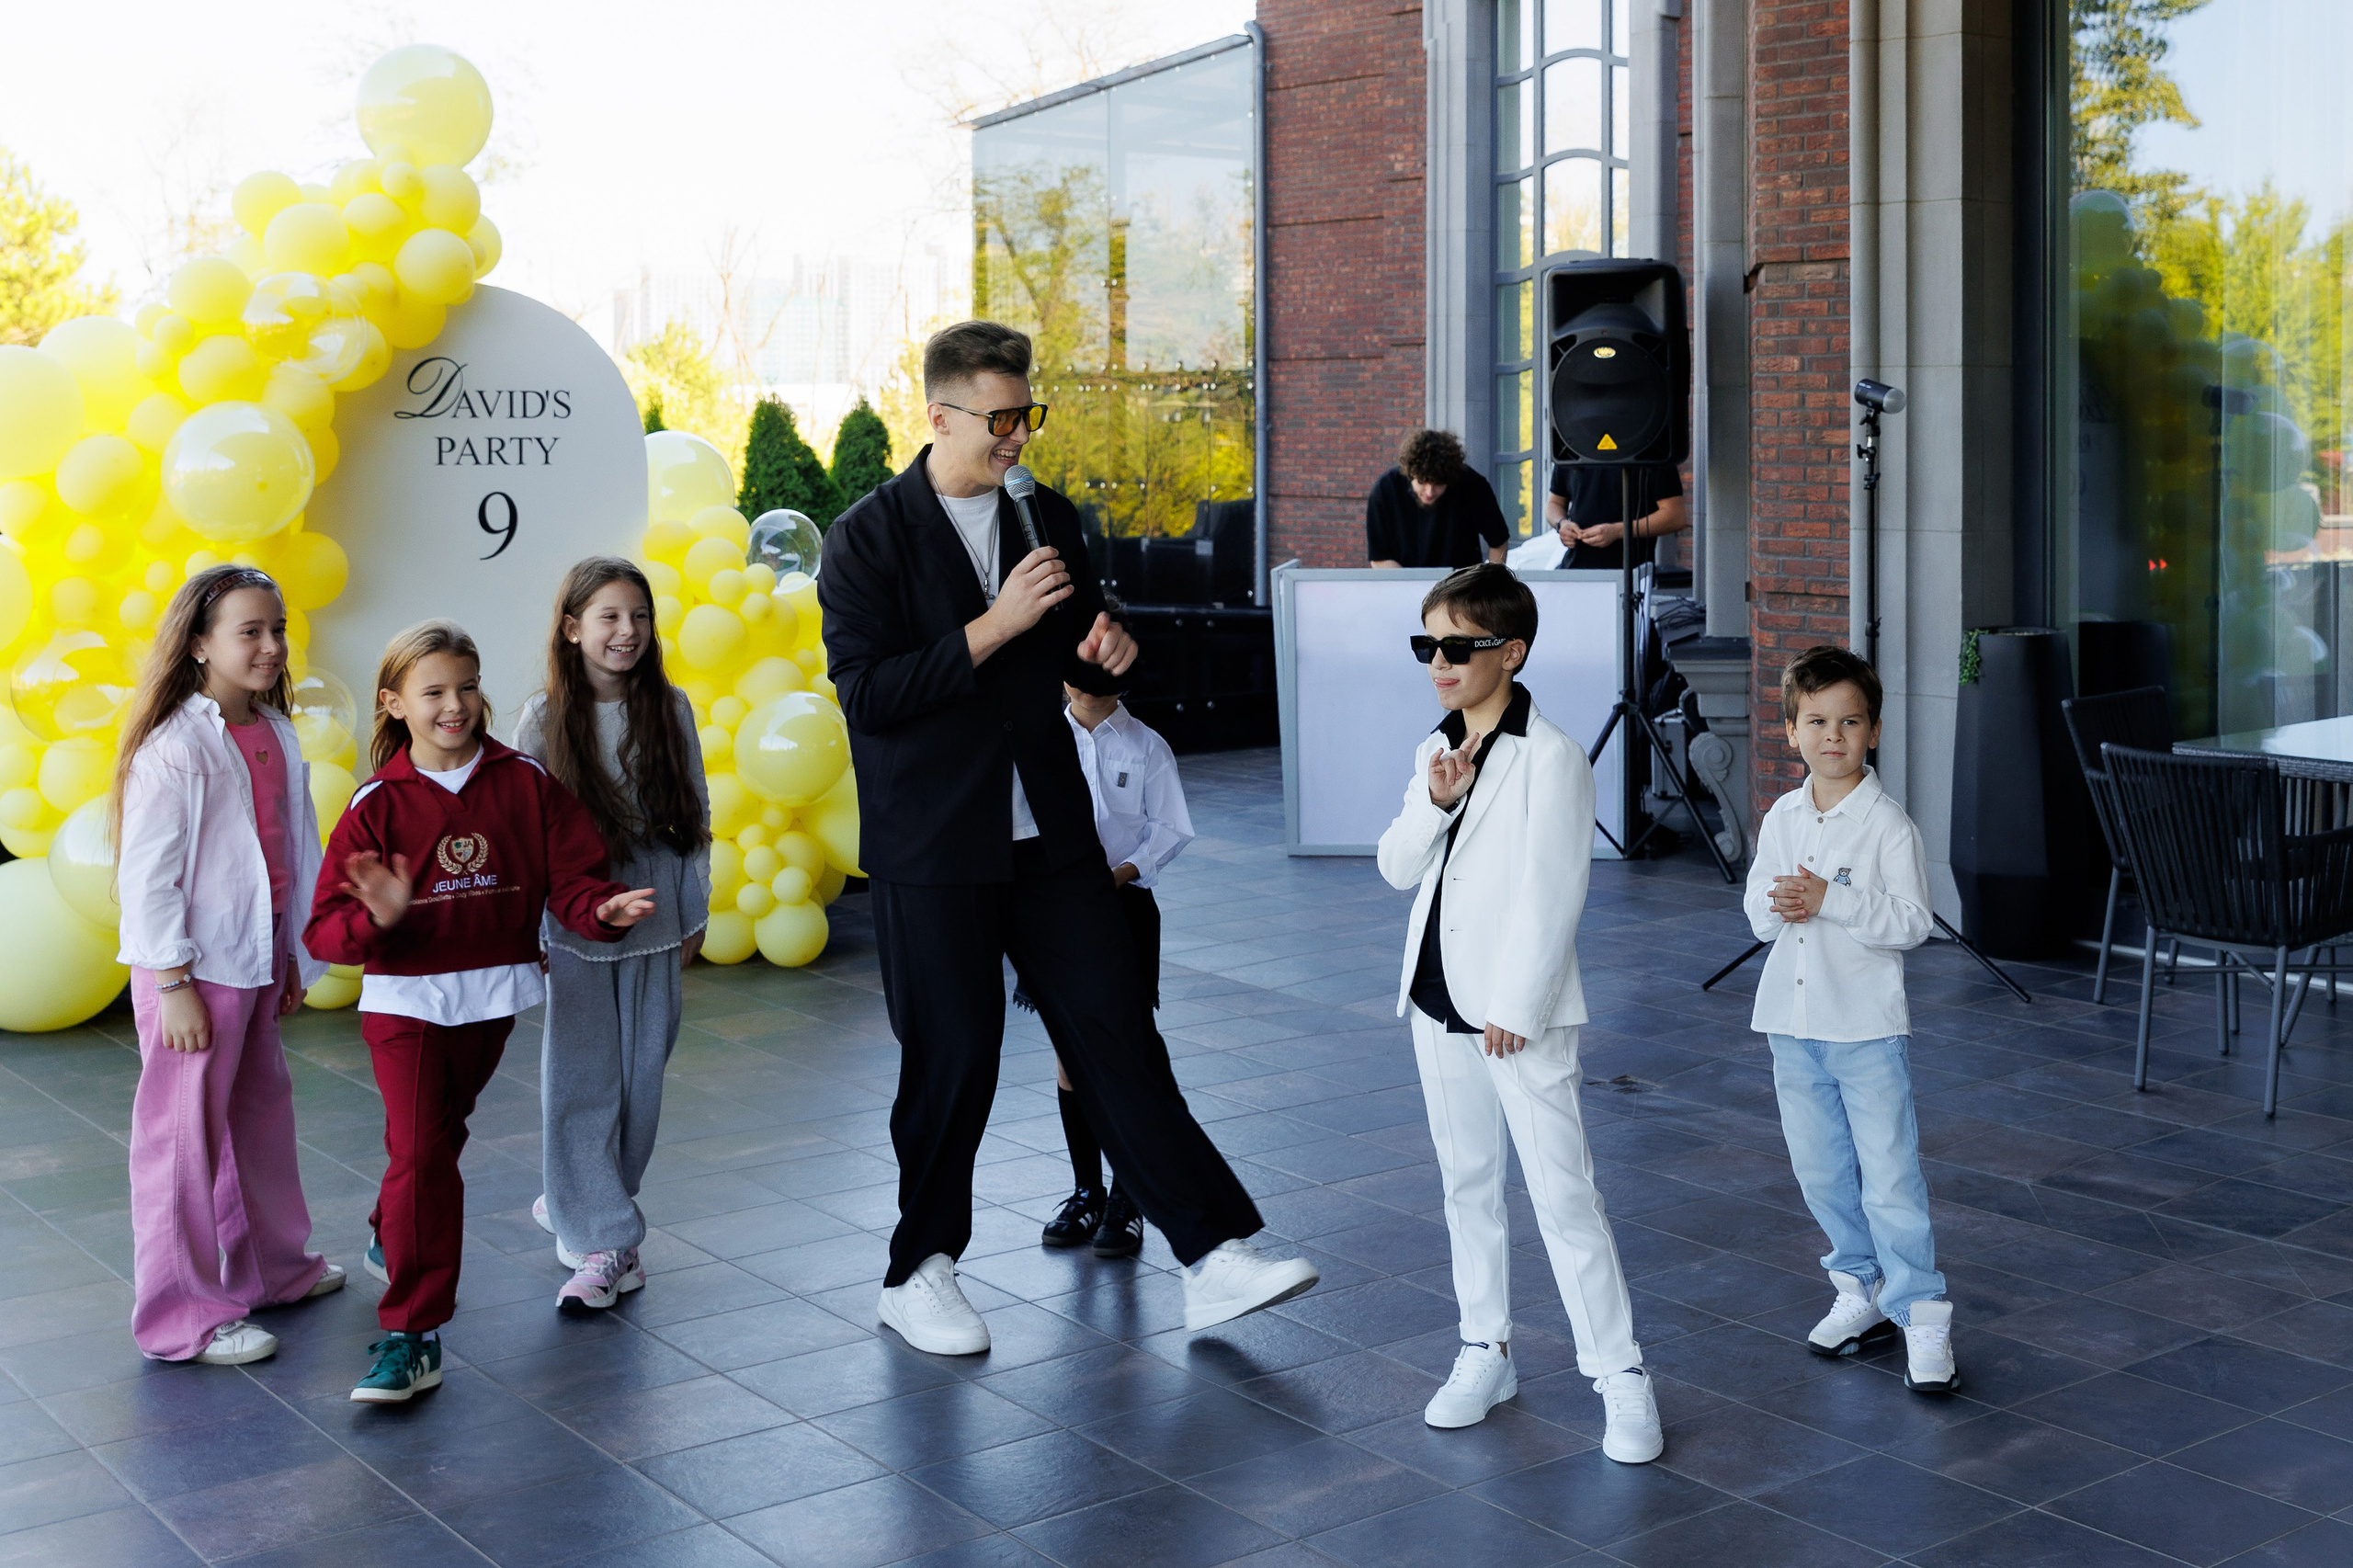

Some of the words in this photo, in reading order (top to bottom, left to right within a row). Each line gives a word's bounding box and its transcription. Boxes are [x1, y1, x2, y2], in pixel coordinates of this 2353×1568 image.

[393, 356, 572, 419] DAVID'S
[435, 436, 561, 466] PARTY
[477, 491, 518, 561] 9
[432, 877, 471, 893] JEUNE
[473, 873, 497, 888] ÂME
